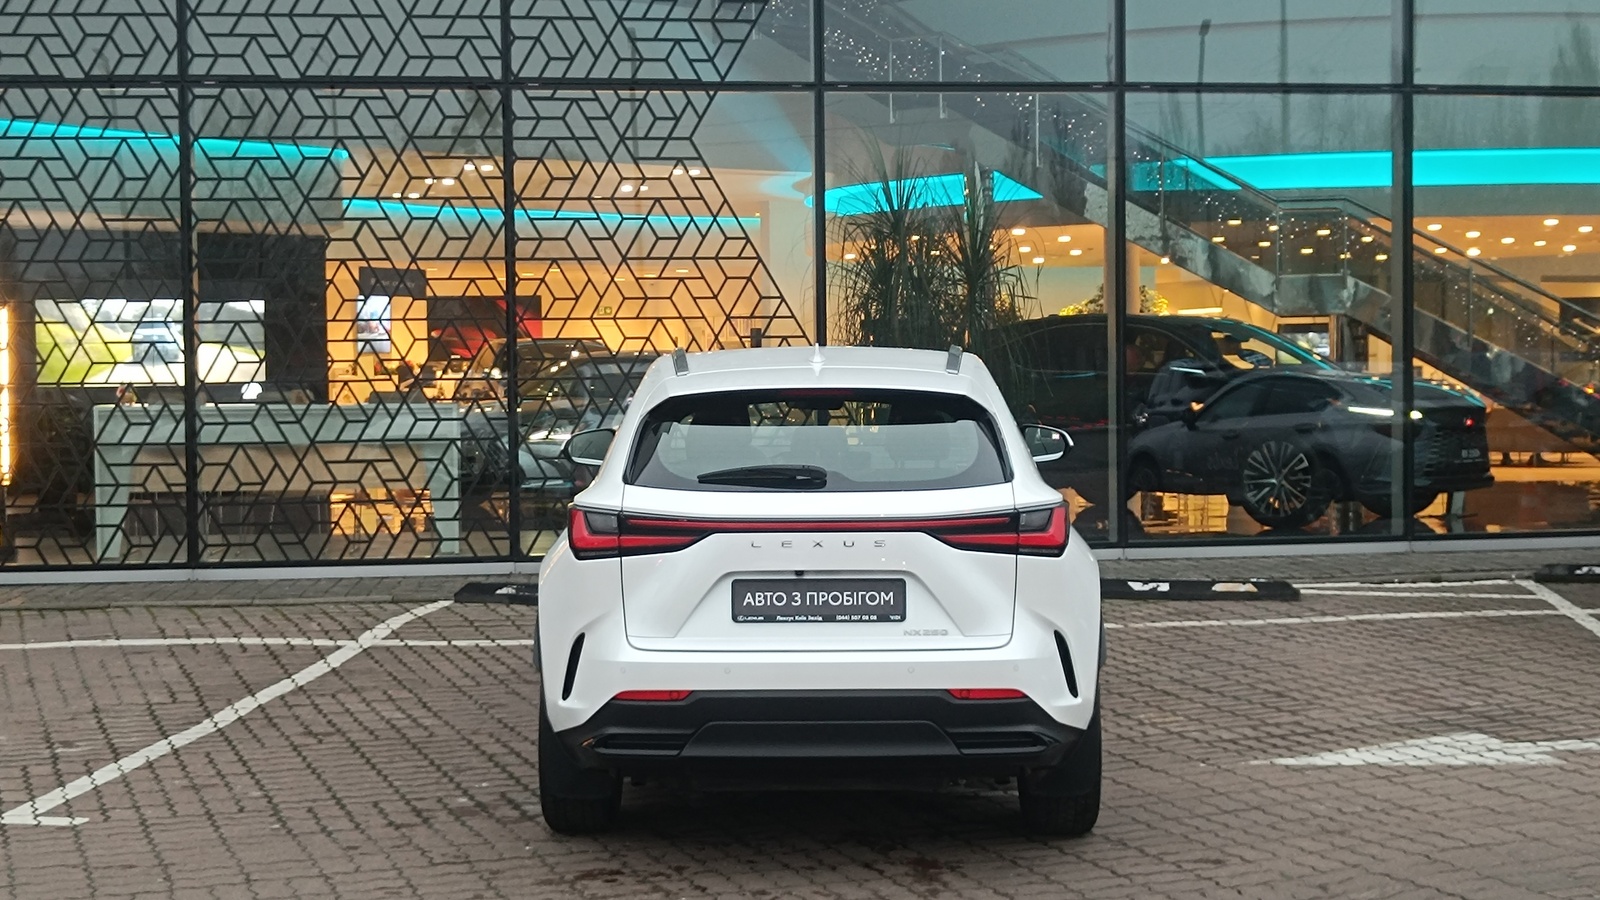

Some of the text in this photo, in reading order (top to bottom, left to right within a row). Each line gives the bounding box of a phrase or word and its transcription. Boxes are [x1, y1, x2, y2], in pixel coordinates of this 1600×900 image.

[751, 540, 886, 548] LEXUS
[743, 591, 894, 606] АВТО З ПРОБІГОМ
